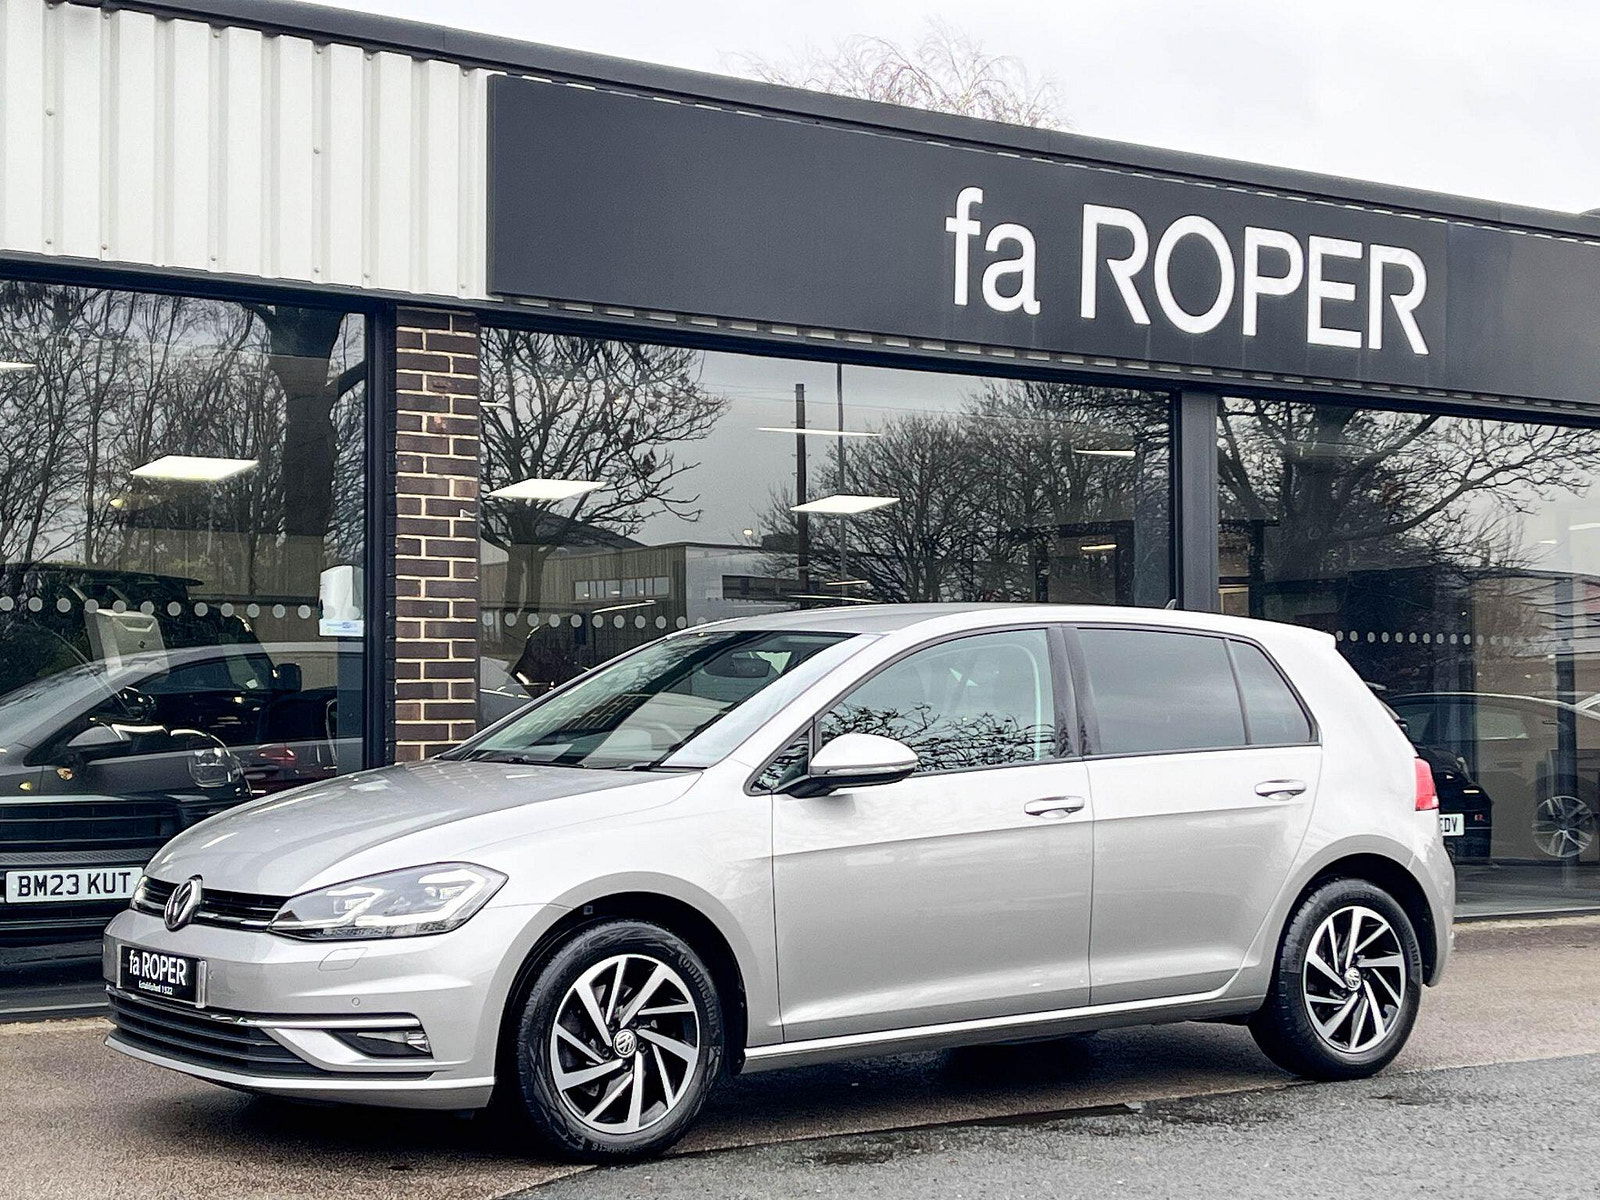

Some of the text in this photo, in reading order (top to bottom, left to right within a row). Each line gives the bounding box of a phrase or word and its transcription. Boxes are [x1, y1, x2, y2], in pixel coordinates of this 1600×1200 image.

[945, 187, 1429, 354] fa ROPER
[17, 872, 131, 897] BM23 KUT
[129, 949, 187, 986] fa ROPER
